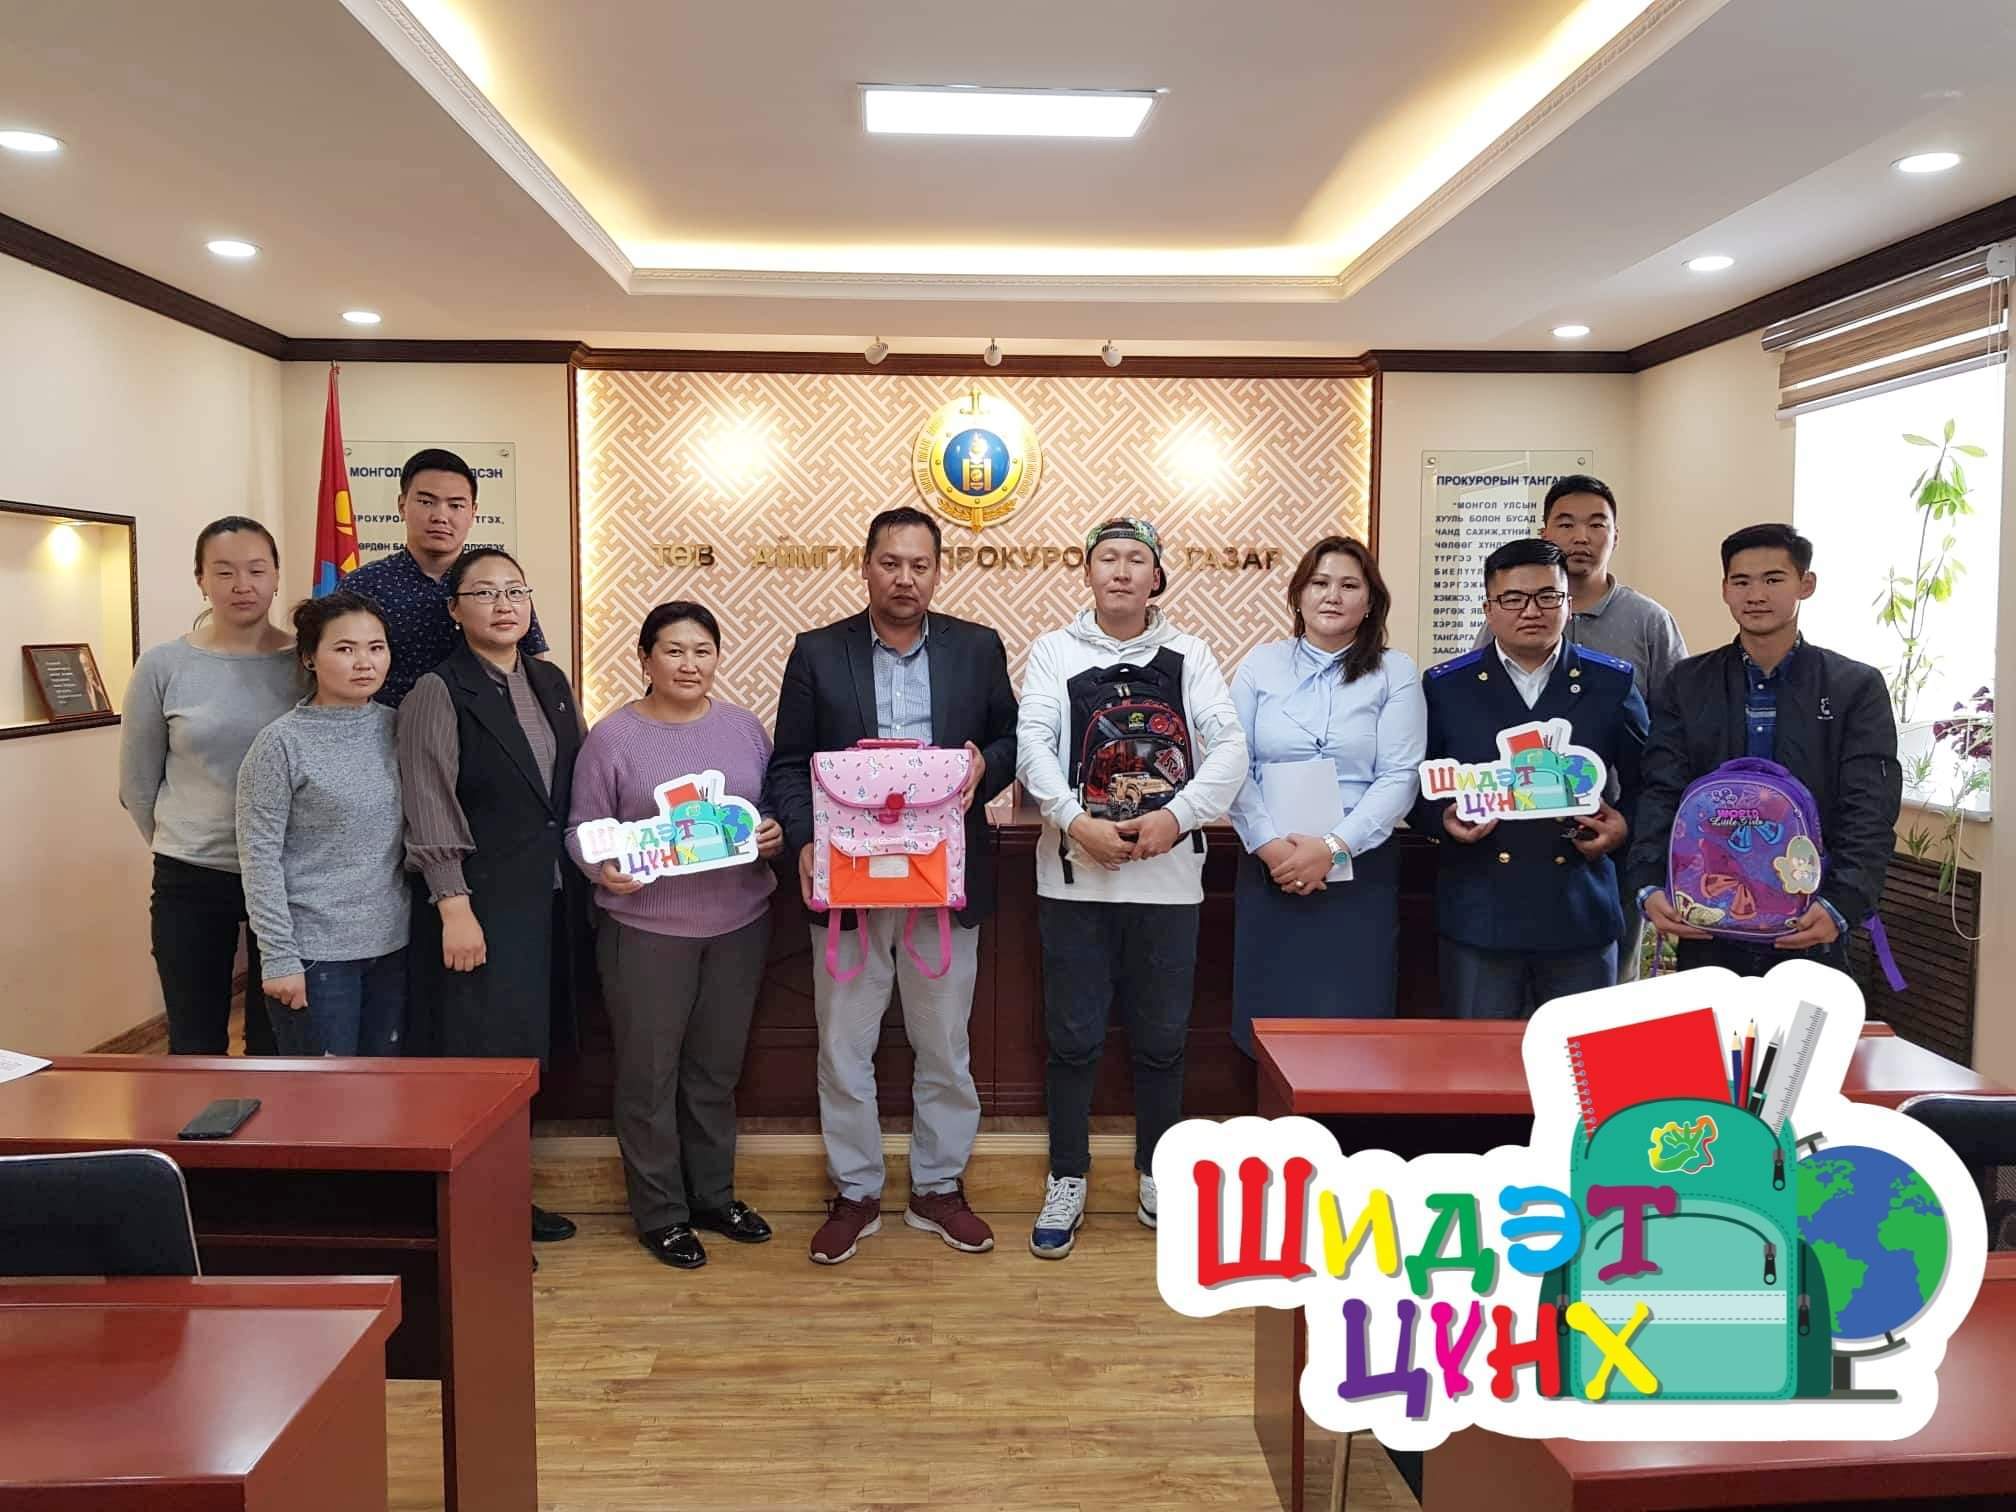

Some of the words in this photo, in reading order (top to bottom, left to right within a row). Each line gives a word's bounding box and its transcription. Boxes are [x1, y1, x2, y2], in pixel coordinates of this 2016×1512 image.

[1436, 475, 1519, 486] ПРОКУРОРЫН
[1523, 475, 1560, 486] ТАНГА
[1428, 766, 1536, 794] ШИДЭТ
